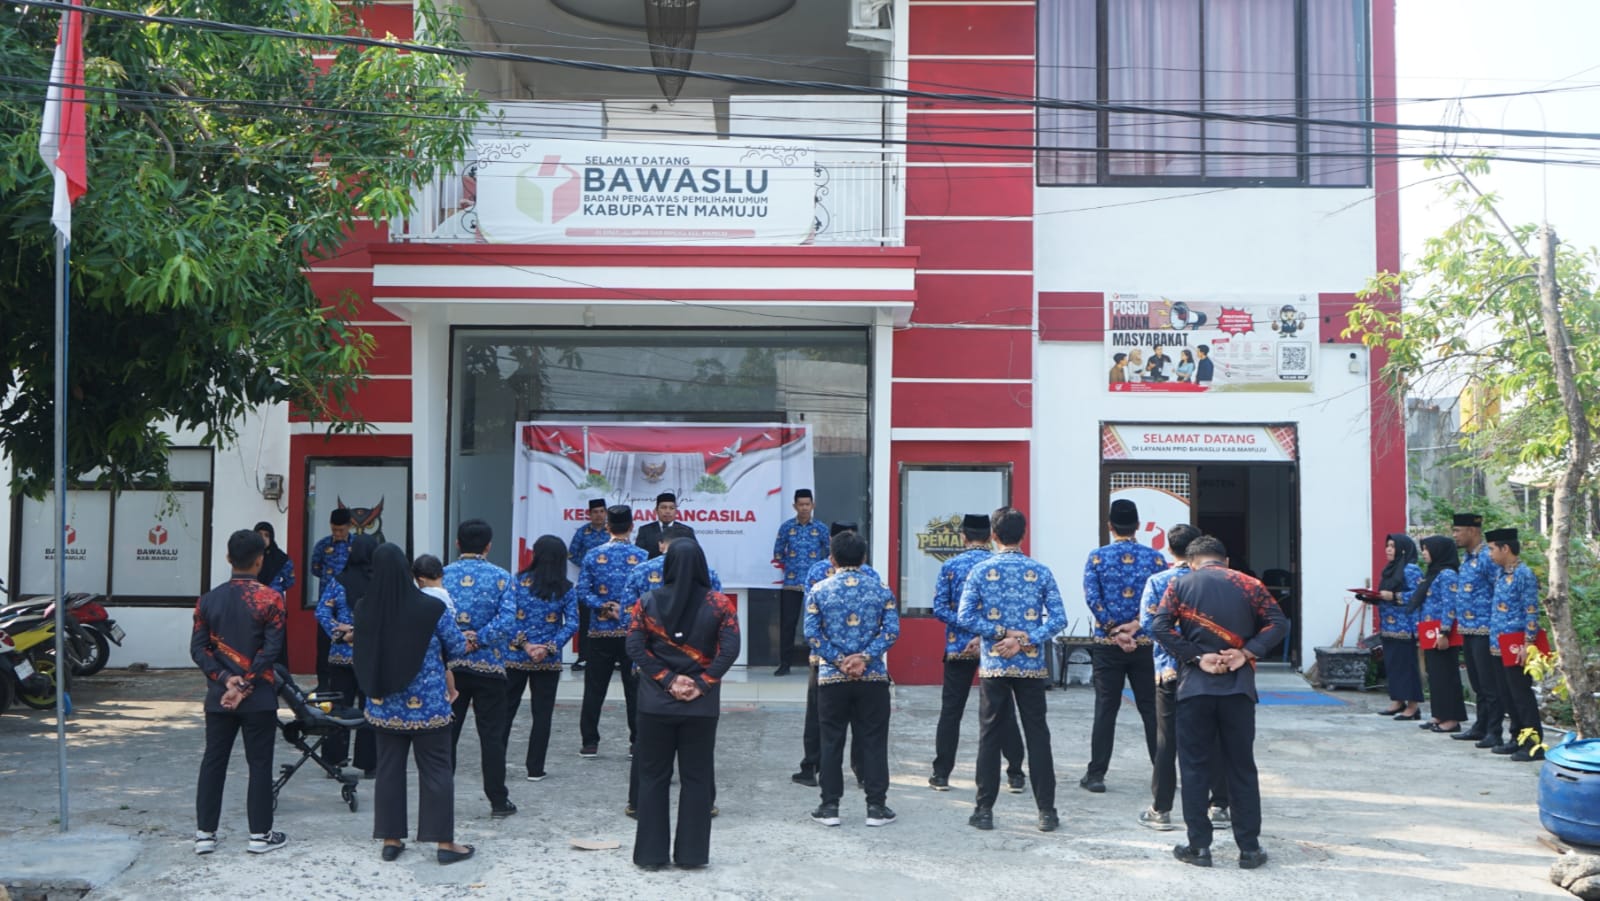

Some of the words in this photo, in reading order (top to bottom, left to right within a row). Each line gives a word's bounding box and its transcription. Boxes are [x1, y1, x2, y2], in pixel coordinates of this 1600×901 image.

[584, 156, 637, 165] SELAMAT
[642, 157, 690, 166] DATANG
[584, 168, 768, 194] BAWASLU
[584, 195, 619, 203] BADAN
[622, 196, 679, 204] PENGAWAS
[738, 197, 768, 205] UMUM
[583, 205, 688, 217] KABUPATEN
[694, 206, 767, 218] MAMUJU
[1113, 301, 1149, 315] POSKO
[1113, 315, 1149, 330] ADUAN
[1112, 332, 1188, 347] MASYARAKAT
[1143, 433, 1200, 443] SELAMAT
[1204, 434, 1256, 444] DATANG
[674, 509, 756, 522] ANCASILA
